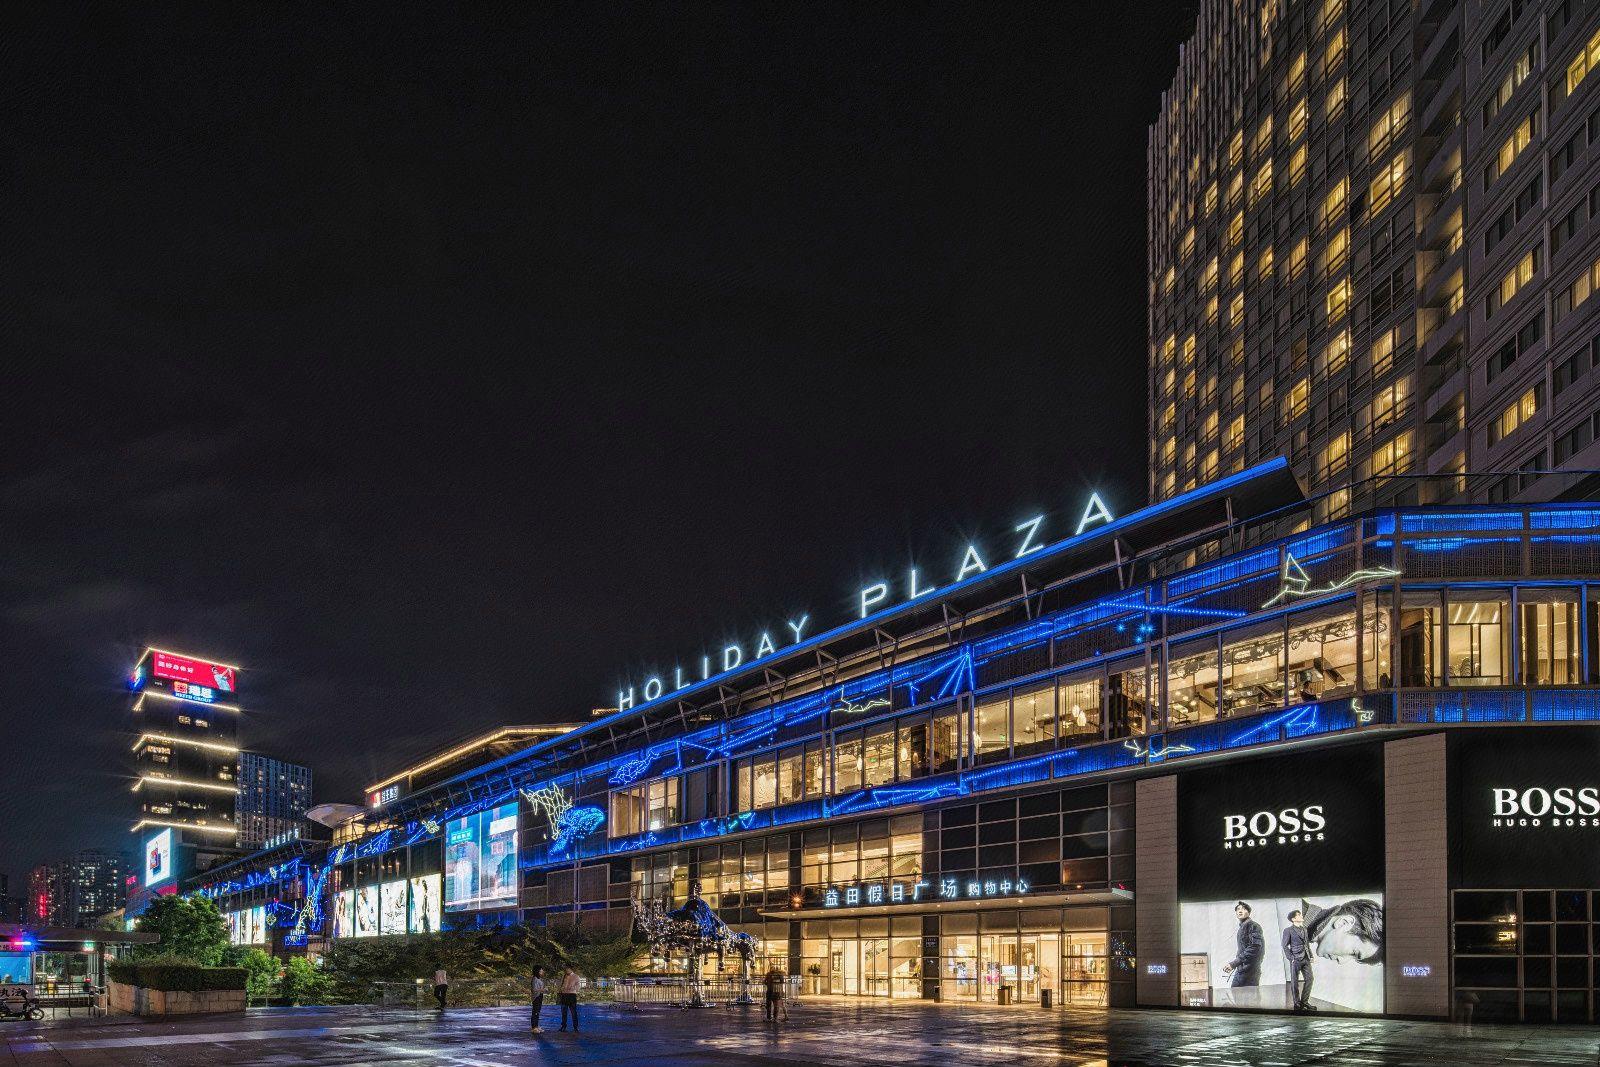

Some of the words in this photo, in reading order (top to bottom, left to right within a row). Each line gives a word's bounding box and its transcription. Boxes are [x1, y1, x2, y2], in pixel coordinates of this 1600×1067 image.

[618, 615, 809, 712] HOLIDAY
[860, 492, 1115, 618] PLAZA
[1492, 787, 1600, 817] BOSS
[1224, 805, 1326, 840] BOSS
[1493, 818, 1541, 827] HUGO
[1553, 818, 1600, 827] BOSS
[1224, 838, 1267, 849] HUGO
[1278, 833, 1324, 845] BOSS
[825, 880, 957, 907] 益田假日广场
[968, 879, 1029, 896] 购物中心
